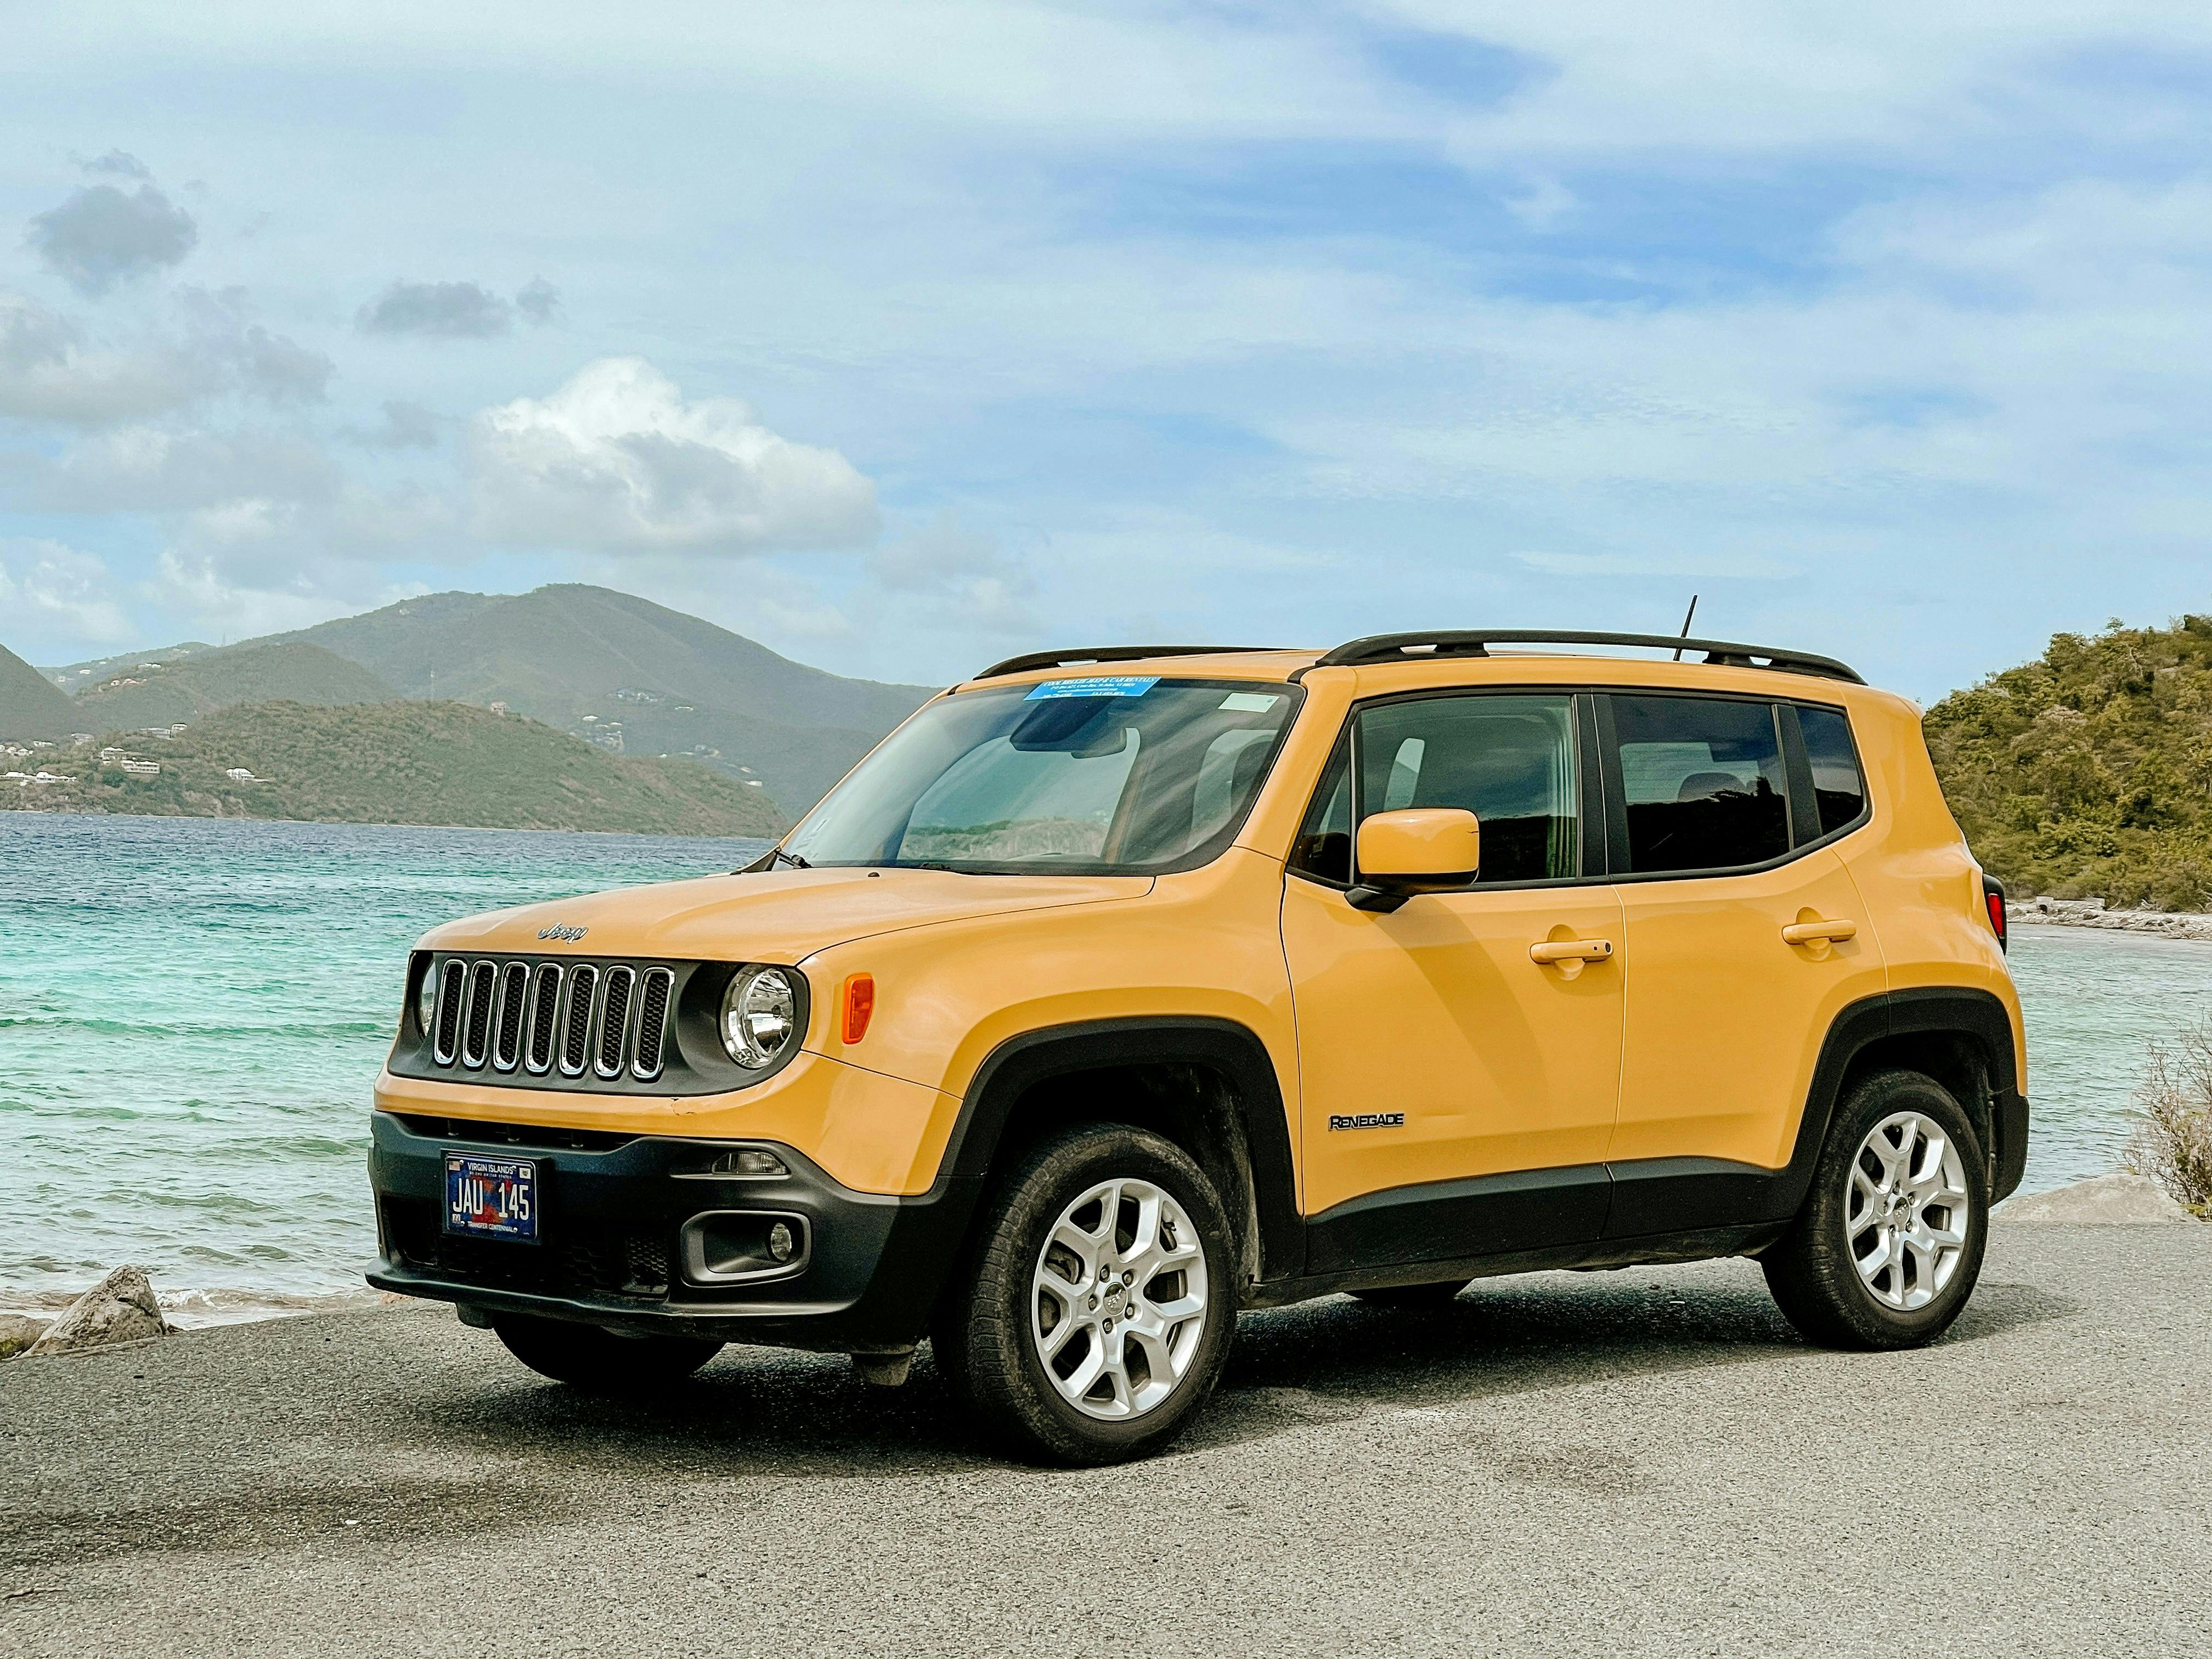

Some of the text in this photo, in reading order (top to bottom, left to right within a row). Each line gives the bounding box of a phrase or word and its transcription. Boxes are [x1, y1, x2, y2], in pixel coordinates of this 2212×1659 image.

[538, 922, 589, 944] Jeep
[1328, 1113, 1404, 1131] RENEGADE
[467, 1162, 514, 1175] VIRGIN ISLANDS
[453, 1178, 529, 1220] JAU 145
